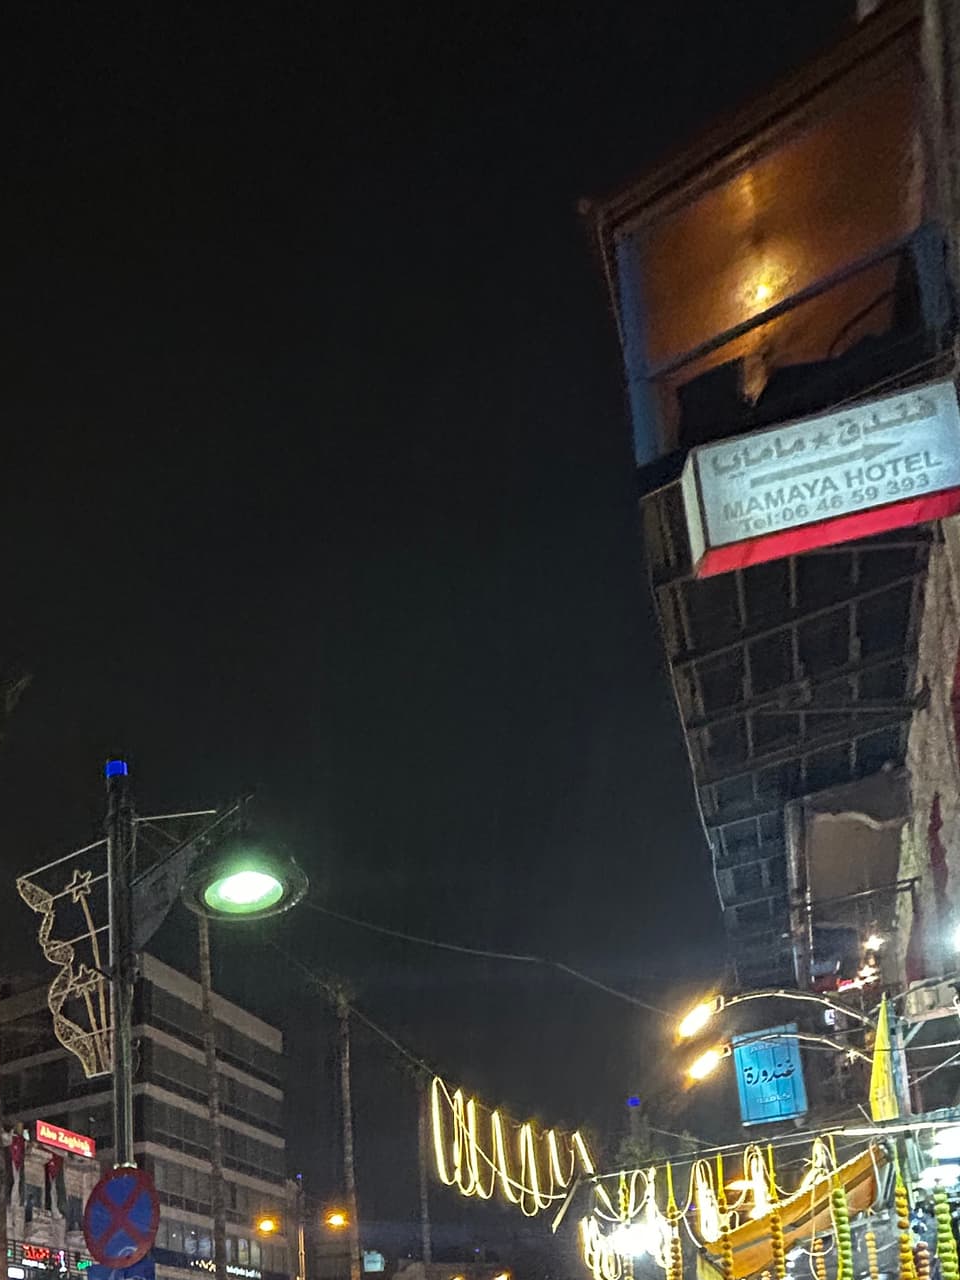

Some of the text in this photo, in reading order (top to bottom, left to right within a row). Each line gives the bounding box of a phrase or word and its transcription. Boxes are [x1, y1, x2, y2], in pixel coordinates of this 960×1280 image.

[723, 451, 942, 522] MAMAYA HOTEL
[851, 485, 879, 505] 59
